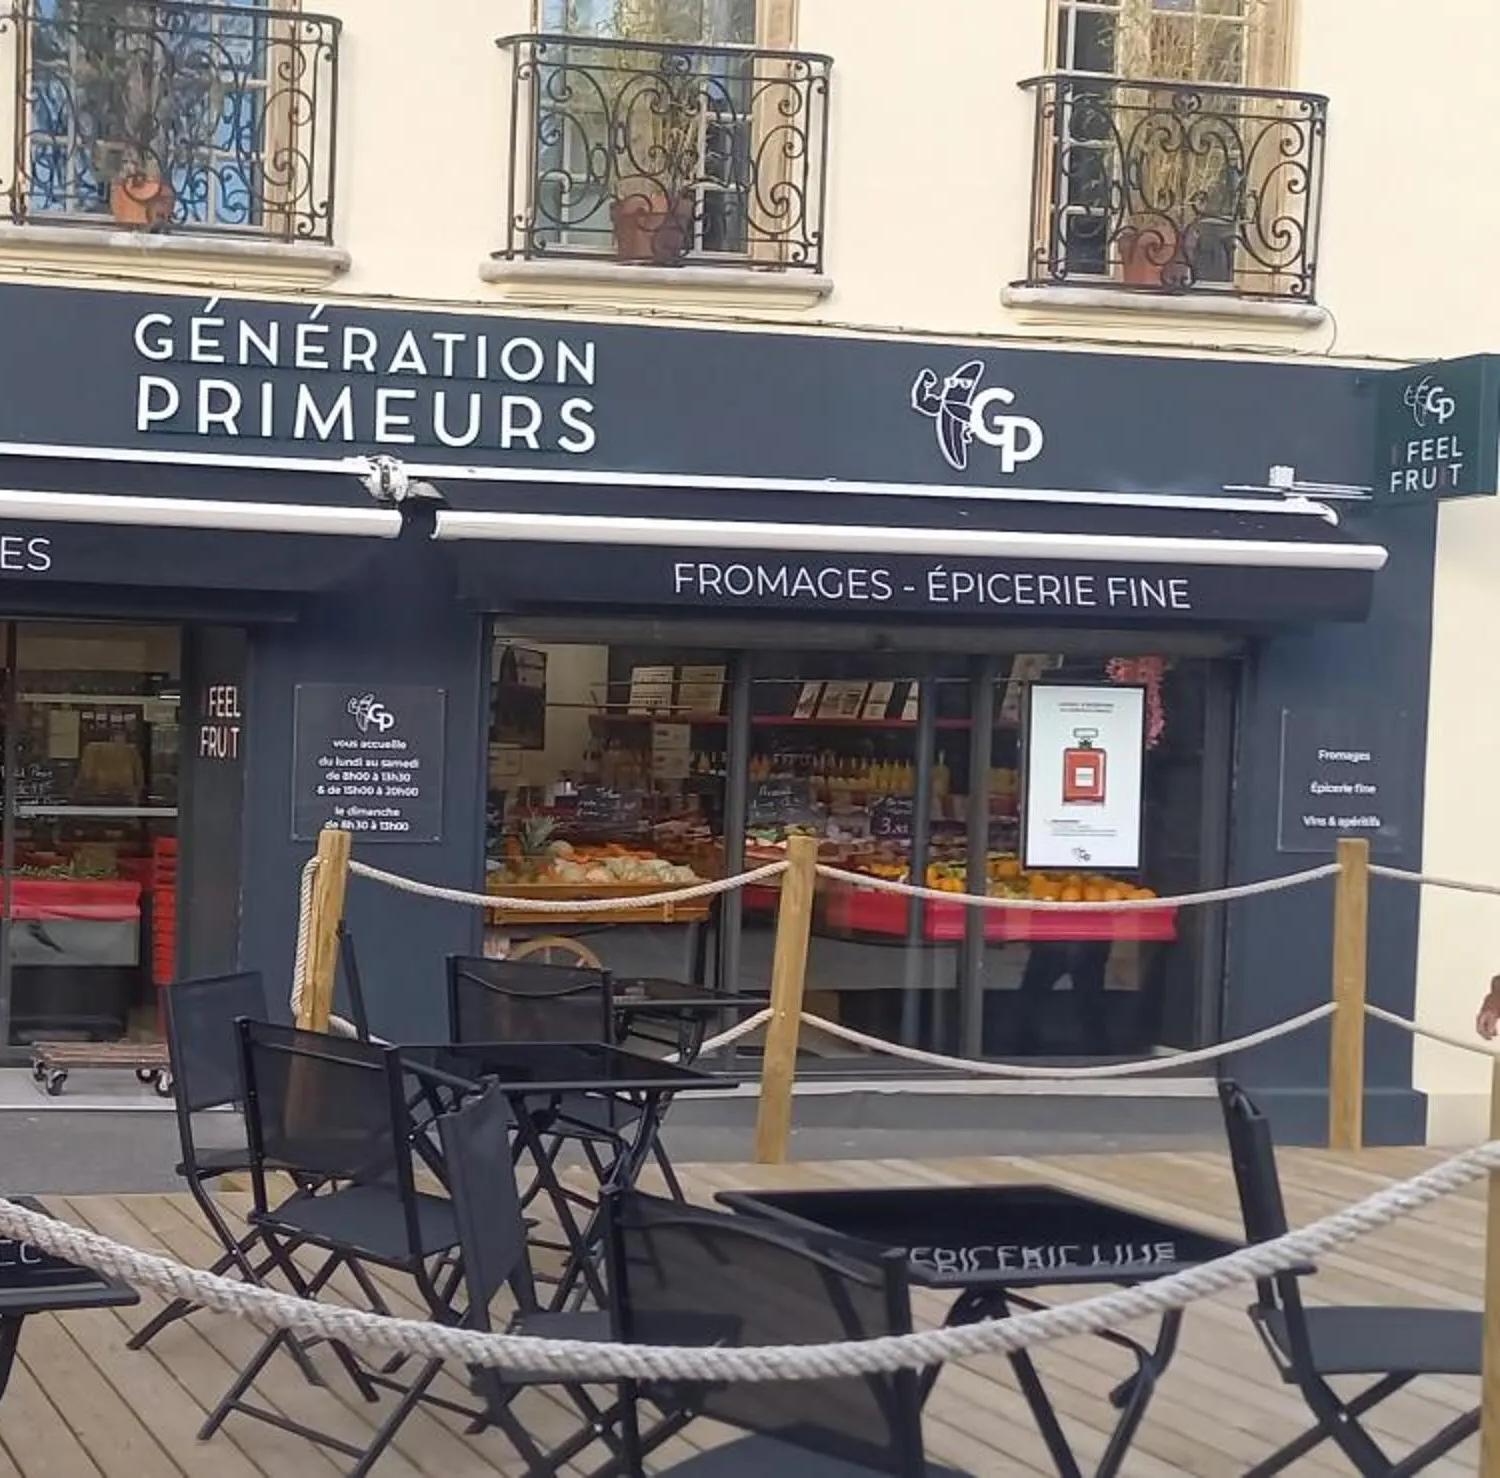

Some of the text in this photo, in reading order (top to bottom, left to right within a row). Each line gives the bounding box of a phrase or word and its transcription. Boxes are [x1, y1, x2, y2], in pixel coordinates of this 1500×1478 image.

[132, 296, 596, 385] GÉNÉRATION
[136, 374, 597, 454] PRIMEURS
[1407, 436, 1463, 463] FEEL
[674, 562, 893, 601] FROMAGES
[927, 564, 1097, 606] ÉPICERIE
[1107, 577, 1191, 609] FINE
[209, 685, 241, 717] FEEL
[332, 739, 407, 750] vous accueille
[318, 755, 420, 769] du lundi au samedi
[1317, 749, 1371, 763] Fromages
[325, 770, 341, 781] de
[326, 785, 342, 795] de
[1310, 780, 1377, 795] Épicerie fine
[334, 805, 401, 817] le dimanche
[324, 819, 339, 830] de
[1303, 815, 1327, 827] Vins
